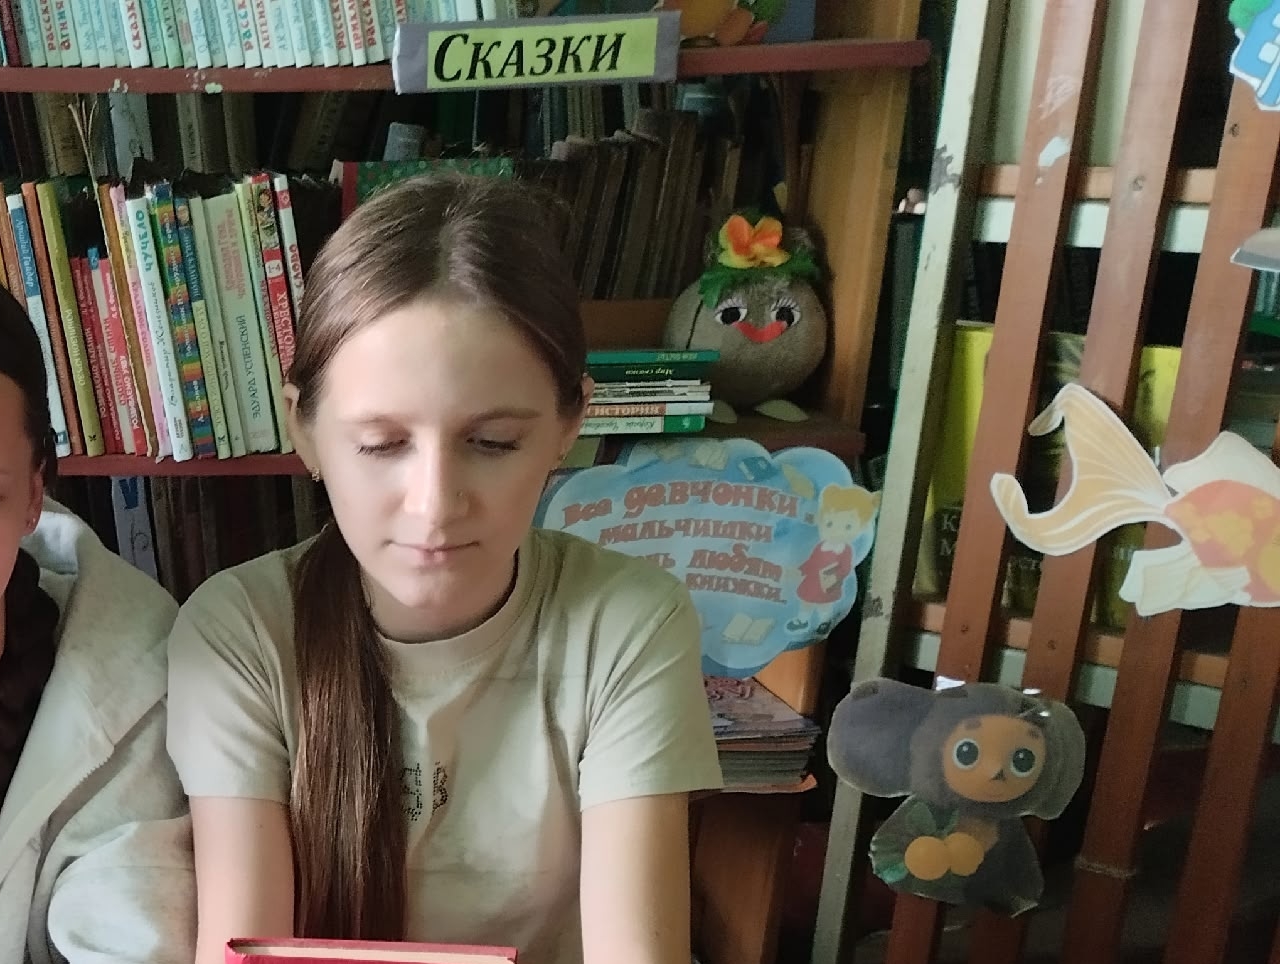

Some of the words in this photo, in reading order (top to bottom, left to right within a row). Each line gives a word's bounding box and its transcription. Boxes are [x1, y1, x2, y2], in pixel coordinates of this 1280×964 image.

[135, 209, 153, 272] ЧУЧЕЛО
[21, 255, 35, 287] Гайдар
[62, 309, 81, 356] РОБИНЗОН
[72, 356, 87, 386] КРУЗО
[233, 314, 257, 376] УСПЕНСКИЙ
[245, 377, 263, 418] ЭДУАРД
[624, 480, 799, 519] девчонки
[599, 518, 775, 544] мальчишки
